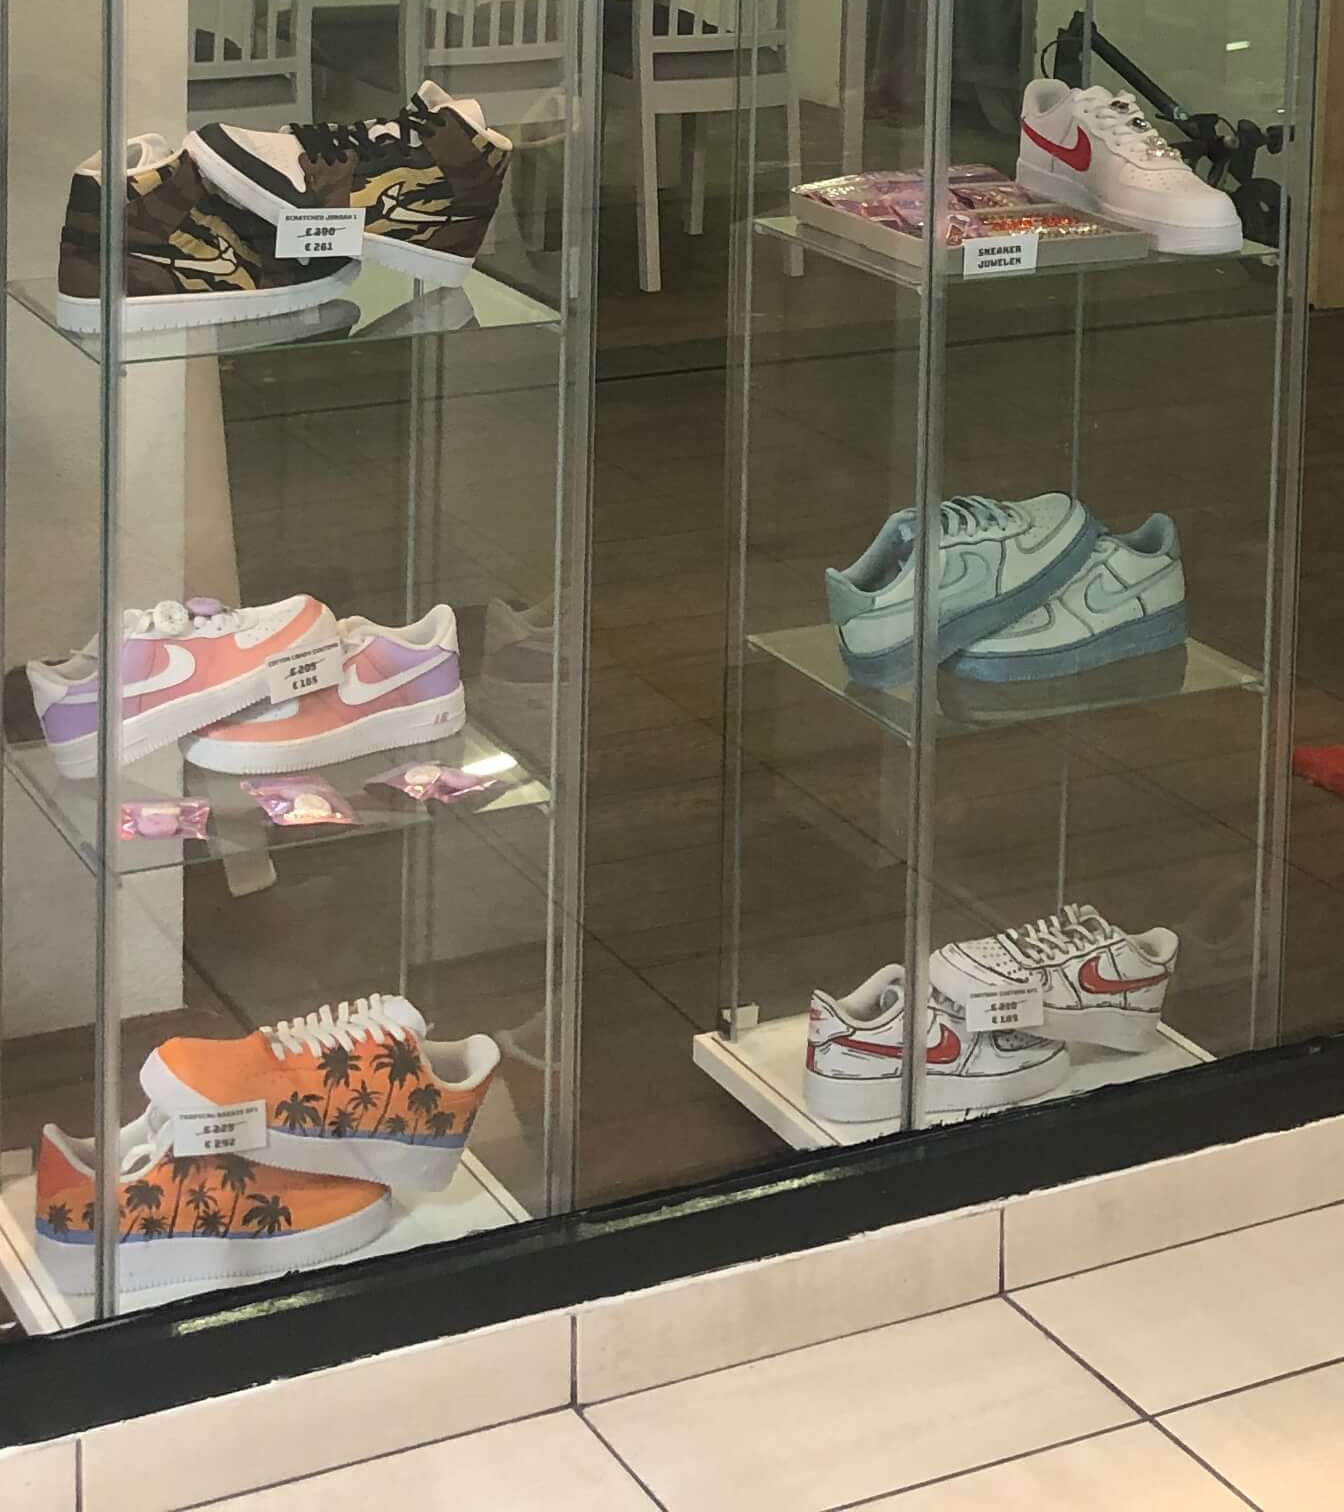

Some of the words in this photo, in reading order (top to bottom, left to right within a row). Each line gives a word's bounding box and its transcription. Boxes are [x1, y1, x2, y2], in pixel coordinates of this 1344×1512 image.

[314, 242, 333, 251] 261
[978, 245, 1022, 257] SNEAKER
[978, 257, 1021, 269] JUWELEN
